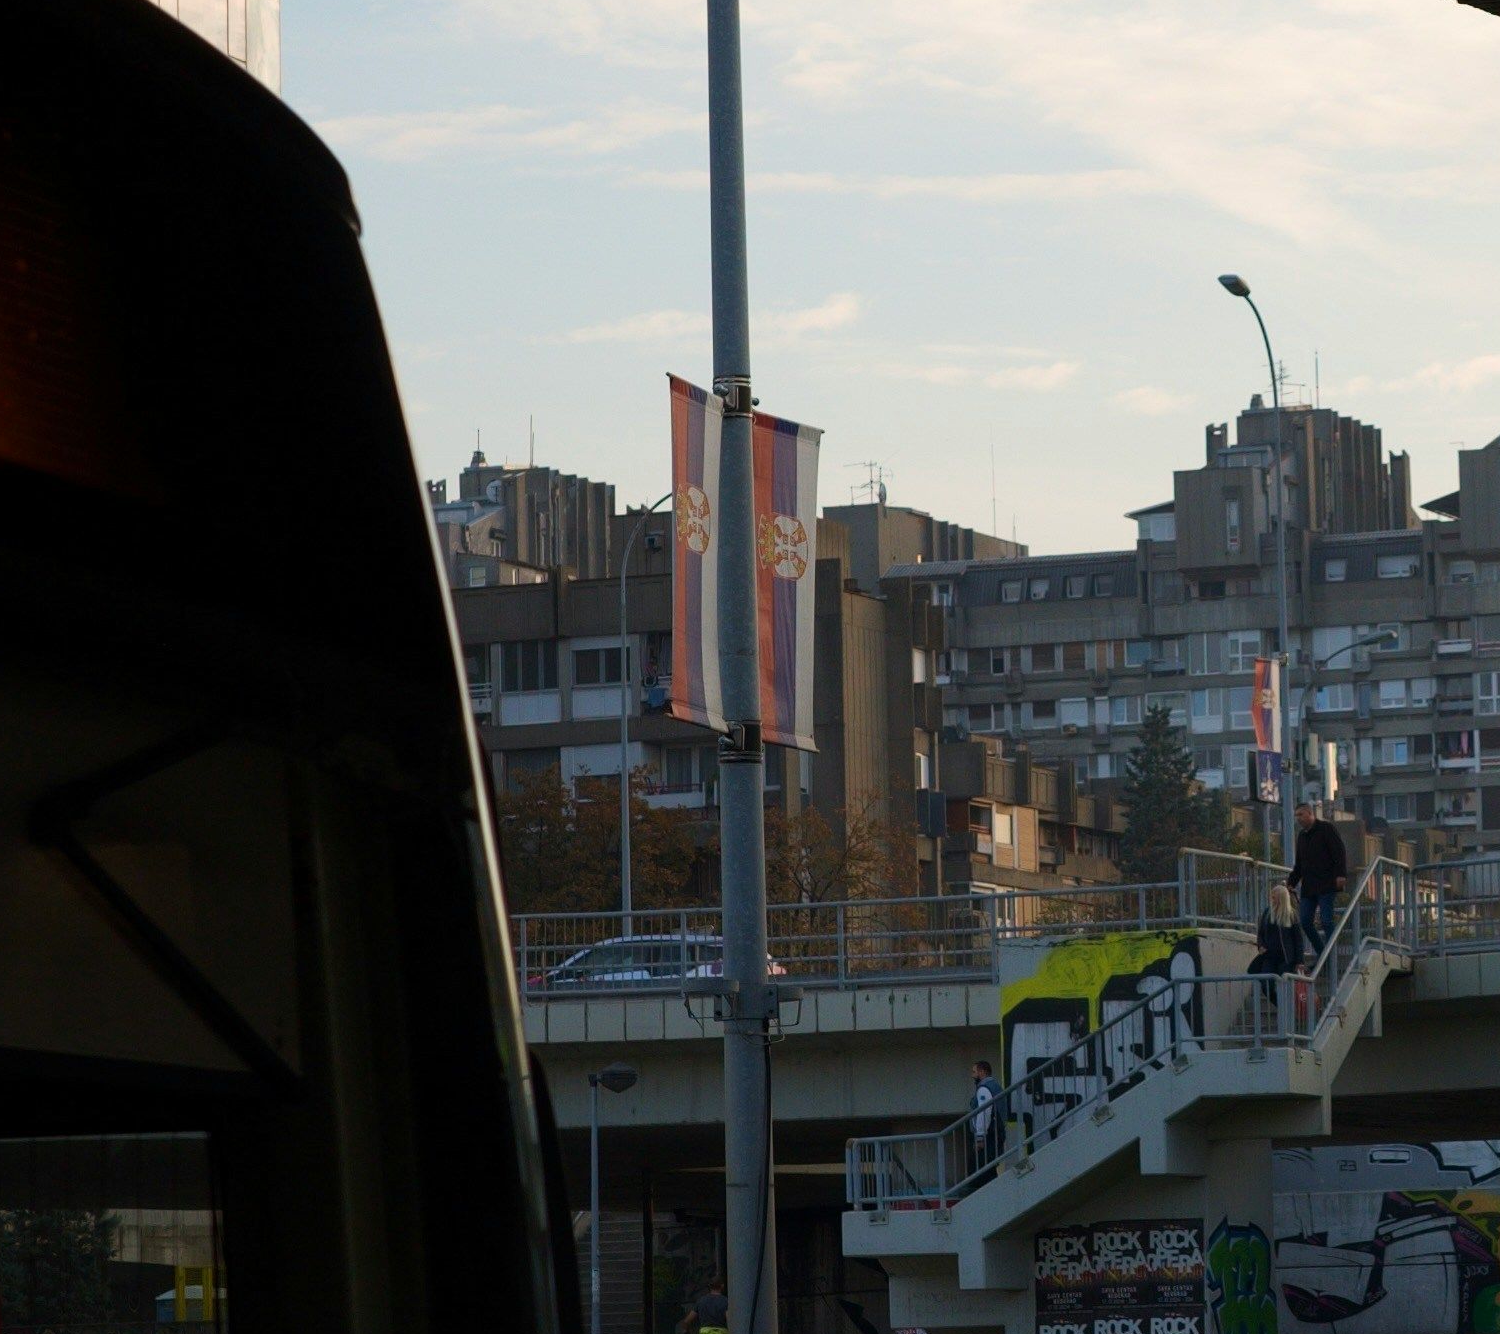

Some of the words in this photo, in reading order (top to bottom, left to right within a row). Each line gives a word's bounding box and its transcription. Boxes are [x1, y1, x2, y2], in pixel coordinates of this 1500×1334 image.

[1038, 1236, 1088, 1257] ROCK
[1093, 1231, 1142, 1251] ROCK
[1150, 1229, 1199, 1249] ROCK
